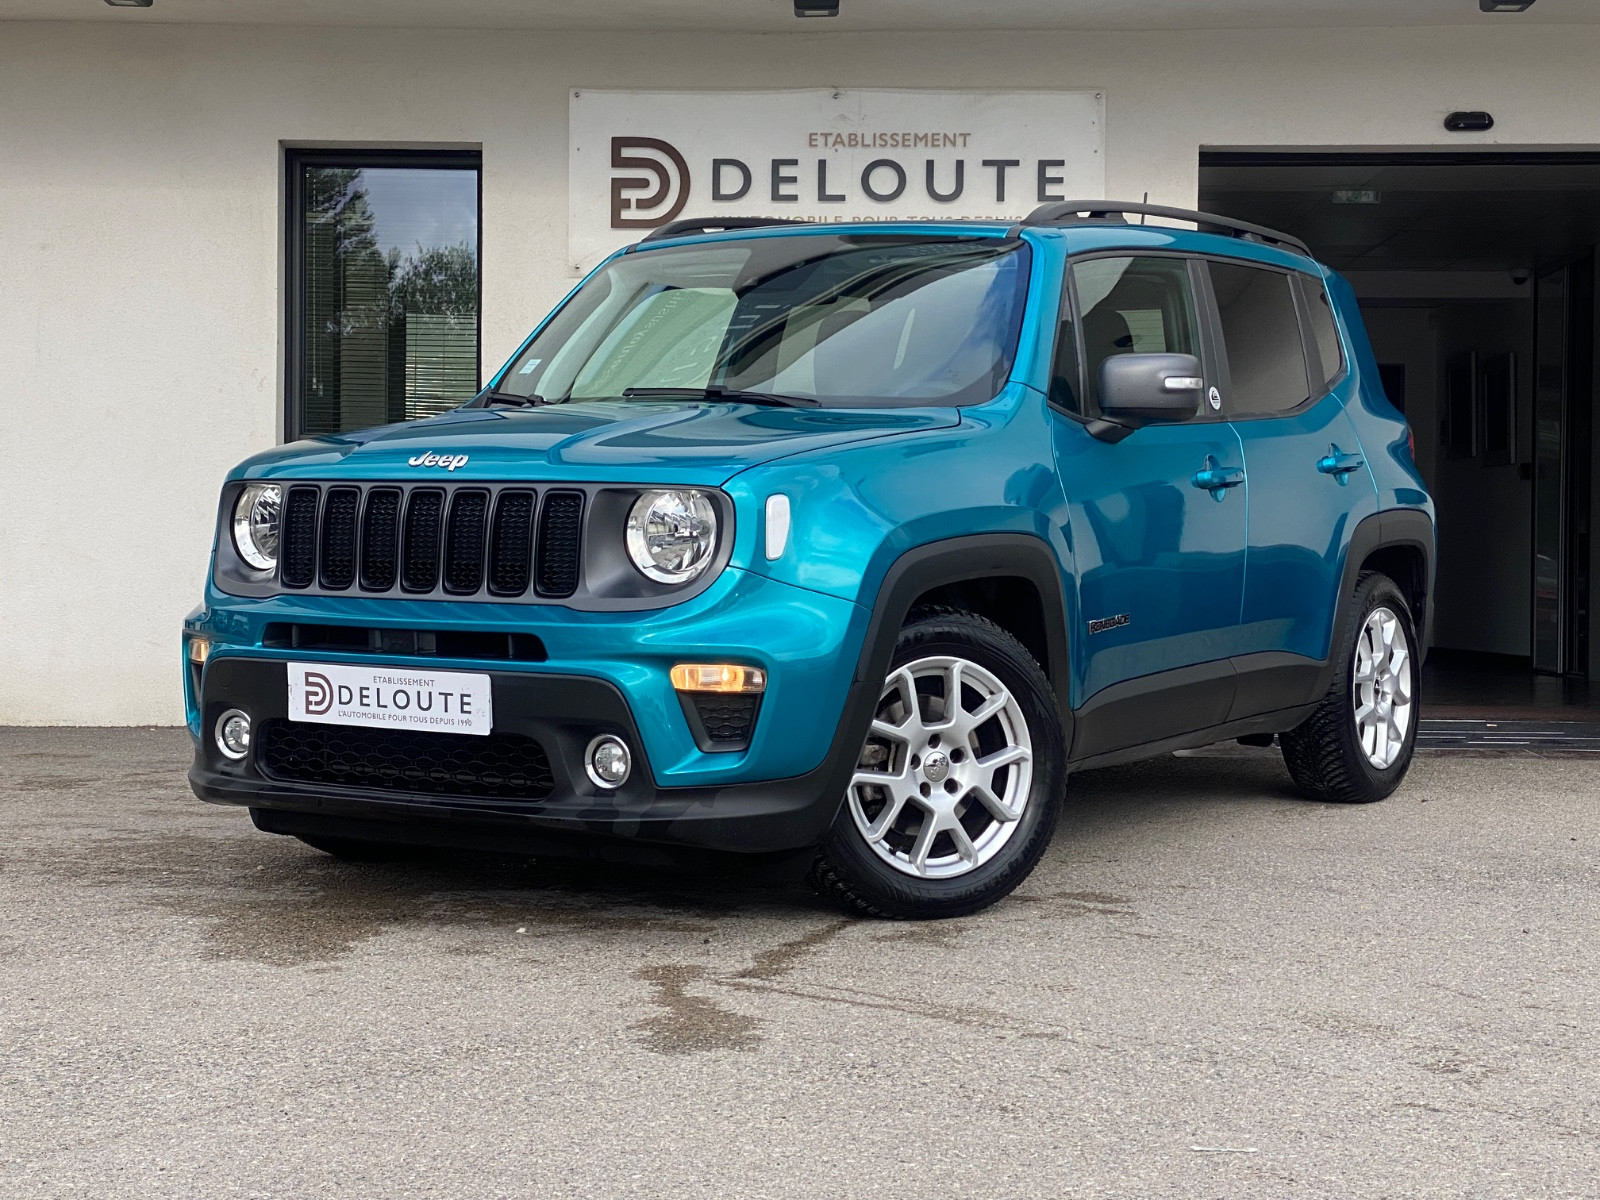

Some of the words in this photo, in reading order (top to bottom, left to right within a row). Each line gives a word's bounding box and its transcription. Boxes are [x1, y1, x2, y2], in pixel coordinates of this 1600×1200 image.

[808, 132, 971, 149] ETABLISSEMENT
[712, 158, 1066, 203] DELOUTE
[408, 450, 469, 472] Jeep
[373, 676, 435, 687] ETABLISSEMENT
[338, 685, 472, 714] DELOUTE
[338, 710, 386, 721] L'AUTOMOBILE
[388, 714, 407, 722] POUR
[409, 715, 428, 724] TOUS
[429, 717, 455, 726] DEPUIS
